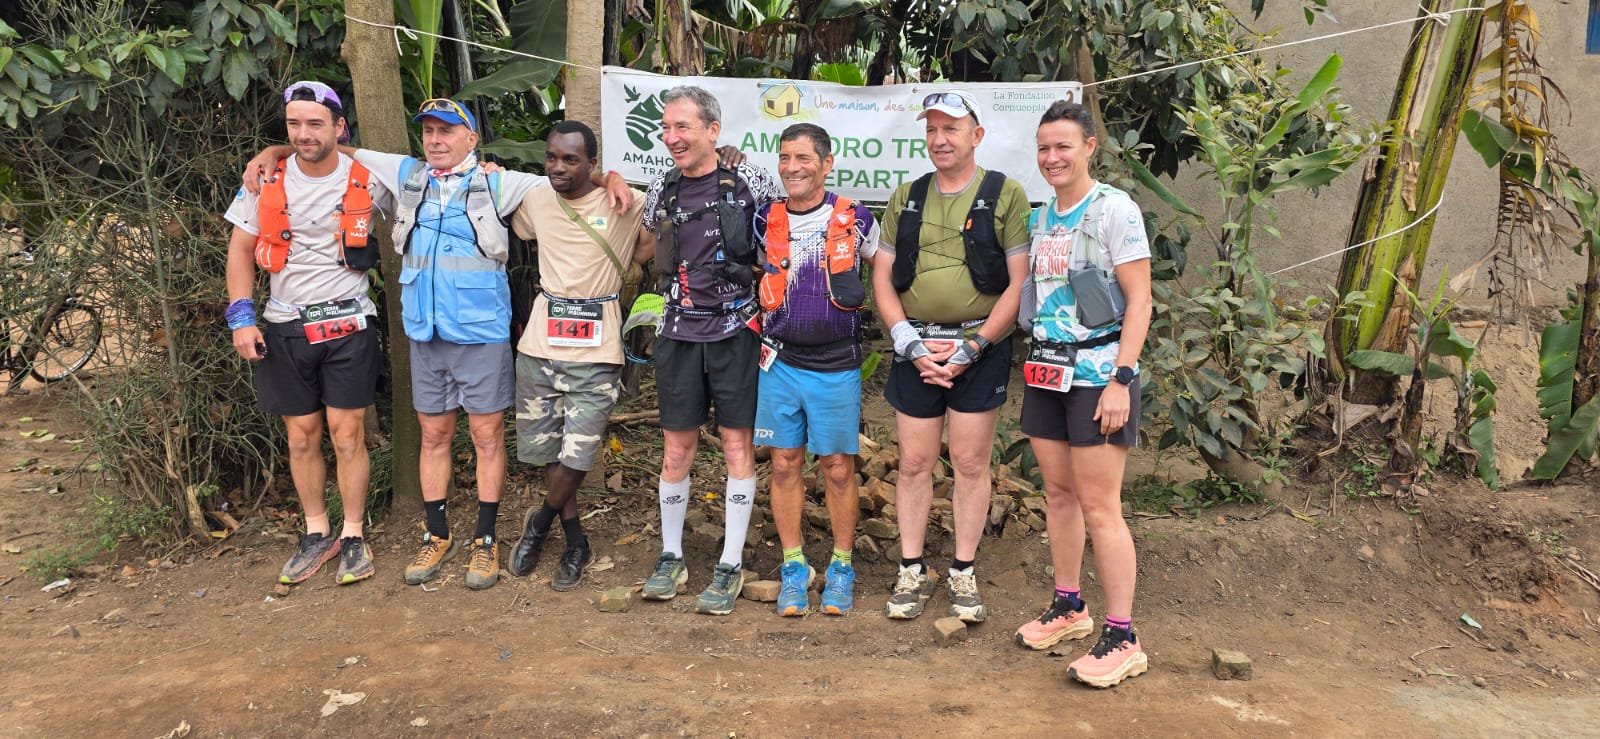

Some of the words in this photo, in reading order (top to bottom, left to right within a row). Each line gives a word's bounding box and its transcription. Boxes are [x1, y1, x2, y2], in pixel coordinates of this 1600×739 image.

[814, 95, 836, 110] Une
[838, 99, 880, 112] maison,
[883, 100, 906, 111] des
[993, 91, 1005, 100] La
[1007, 91, 1055, 100] Fondation
[992, 103, 1046, 113] Cornucopia
[622, 151, 676, 168] AMAHO
[824, 168, 910, 189] EPART
[316, 317, 357, 338] 143
[554, 320, 590, 337] 141
[1030, 365, 1061, 386] 132
[755, 428, 775, 439] TDR
